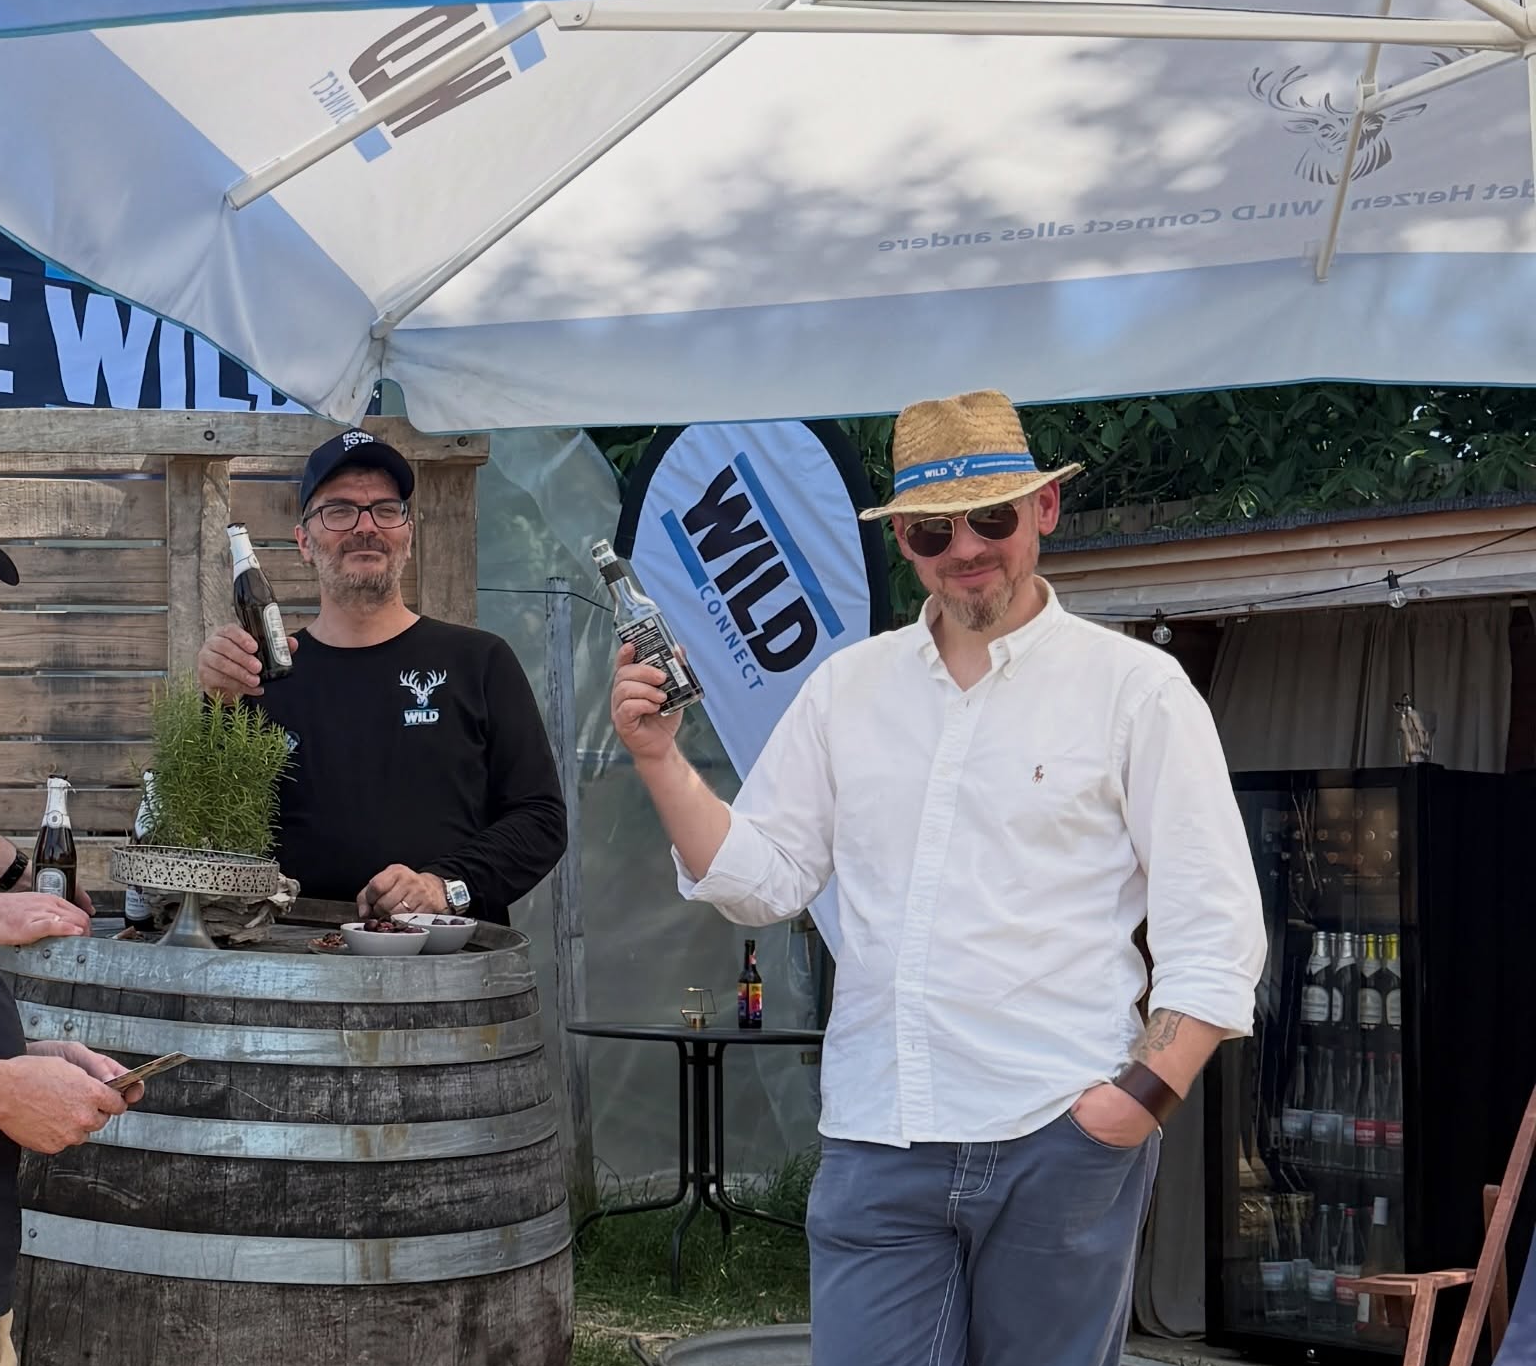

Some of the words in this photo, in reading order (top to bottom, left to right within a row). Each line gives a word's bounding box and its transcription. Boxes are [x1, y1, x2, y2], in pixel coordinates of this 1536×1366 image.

[924, 467, 948, 478] WILD
[682, 464, 818, 673] WILD
[699, 586, 764, 690] CONNECT
[404, 711, 439, 724] WILD
